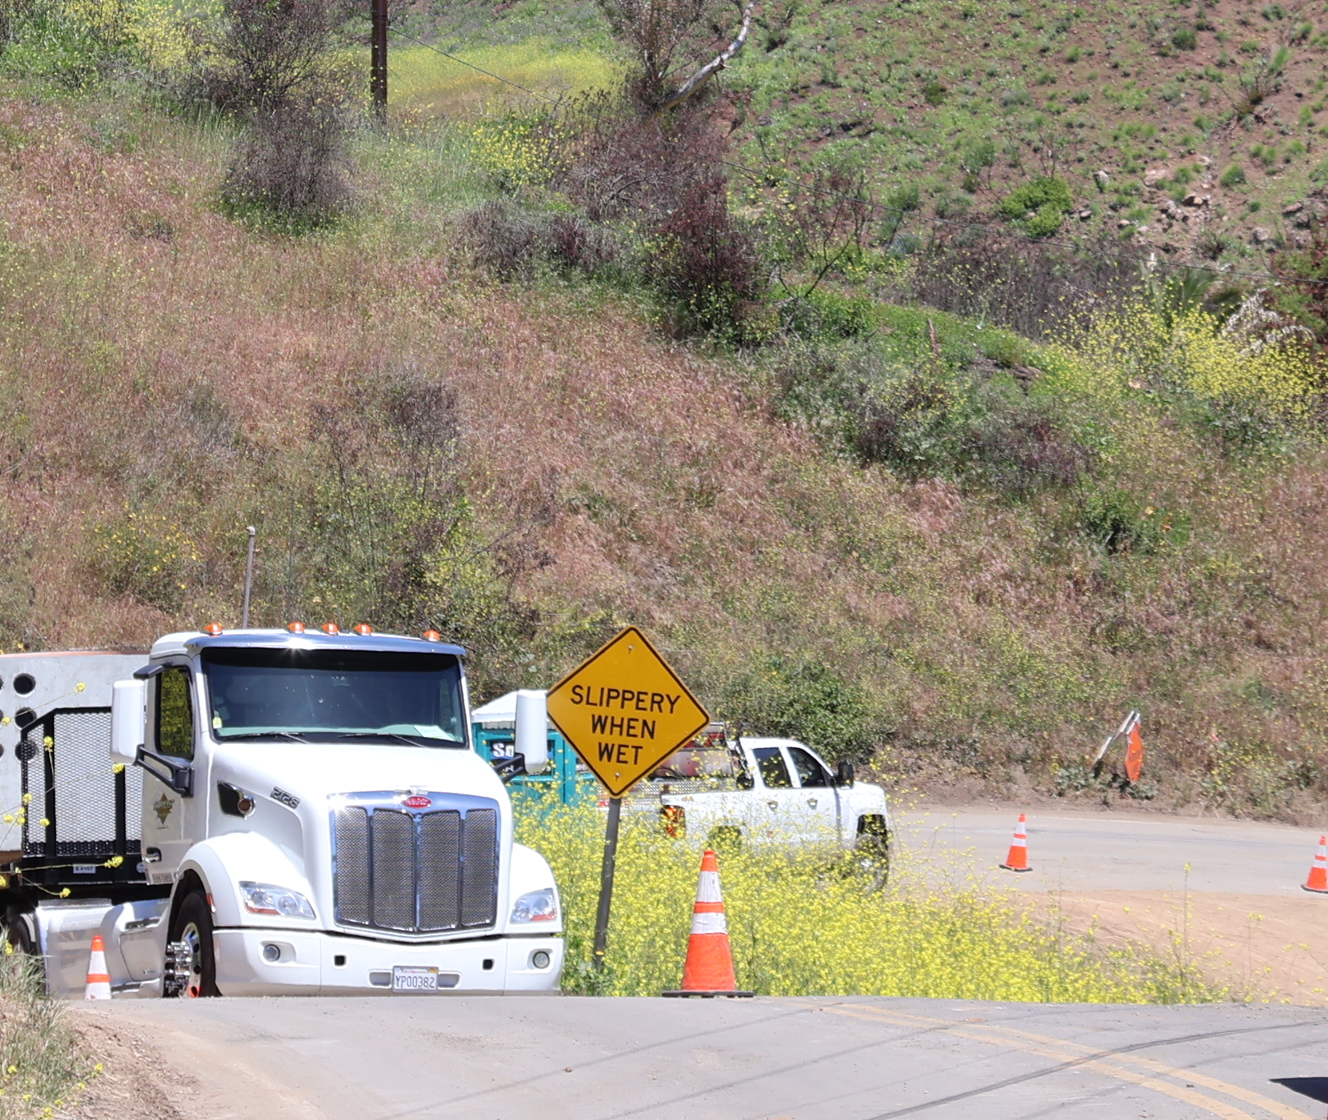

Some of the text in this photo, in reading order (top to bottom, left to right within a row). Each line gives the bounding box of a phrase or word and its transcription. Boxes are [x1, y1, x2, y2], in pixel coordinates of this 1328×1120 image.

[570, 684, 681, 714] SLIPPERY
[591, 714, 656, 740] WHEN
[598, 742, 643, 765] WET
[395, 975, 435, 989] YP00382
